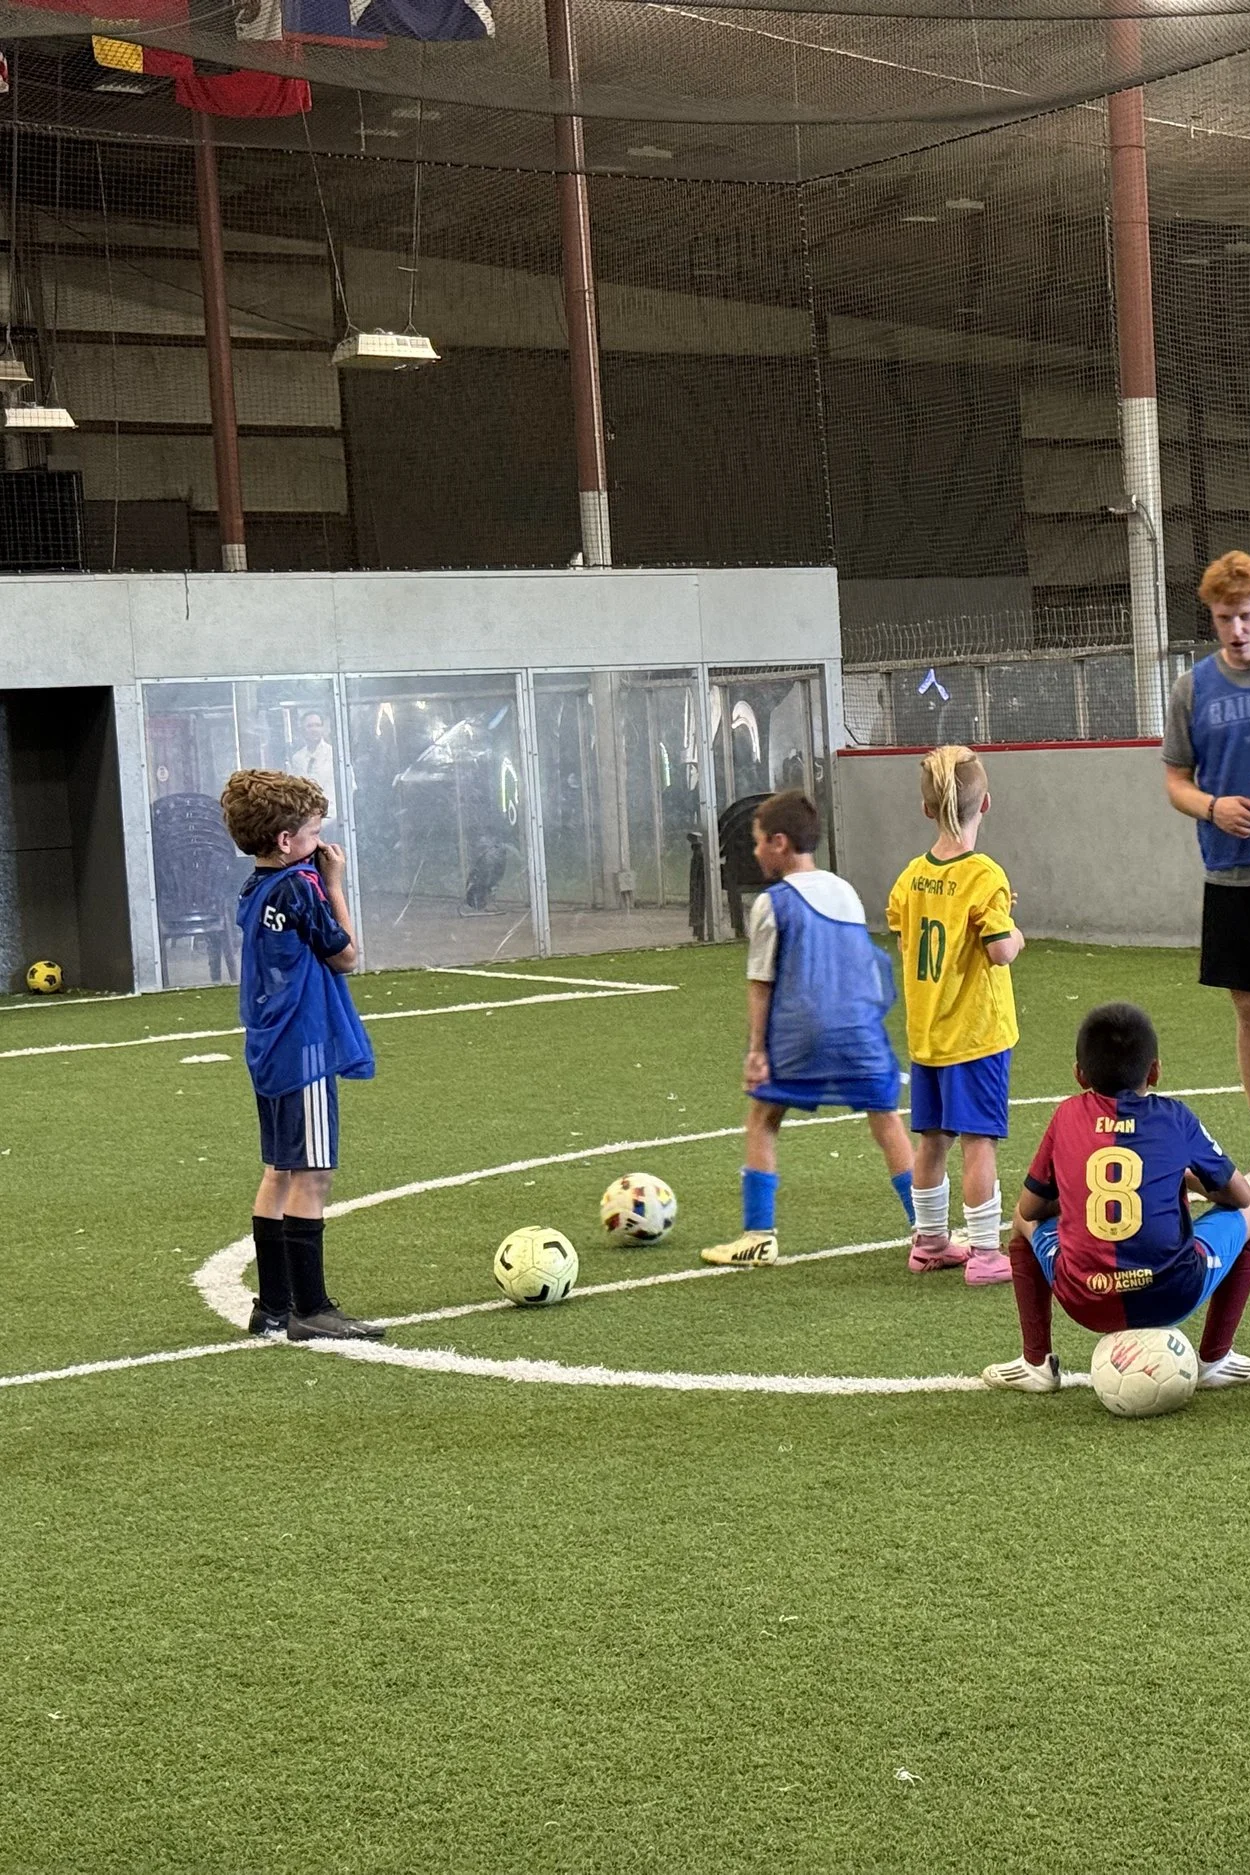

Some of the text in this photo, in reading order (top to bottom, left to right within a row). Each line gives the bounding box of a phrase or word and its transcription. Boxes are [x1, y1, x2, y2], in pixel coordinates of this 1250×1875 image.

[259, 905, 286, 932] ES
[917, 916, 946, 983] 10
[1095, 1116, 1136, 1134] EVAN
[1085, 1146, 1144, 1242] 8
[1113, 1268, 1153, 1280] UNHCR
